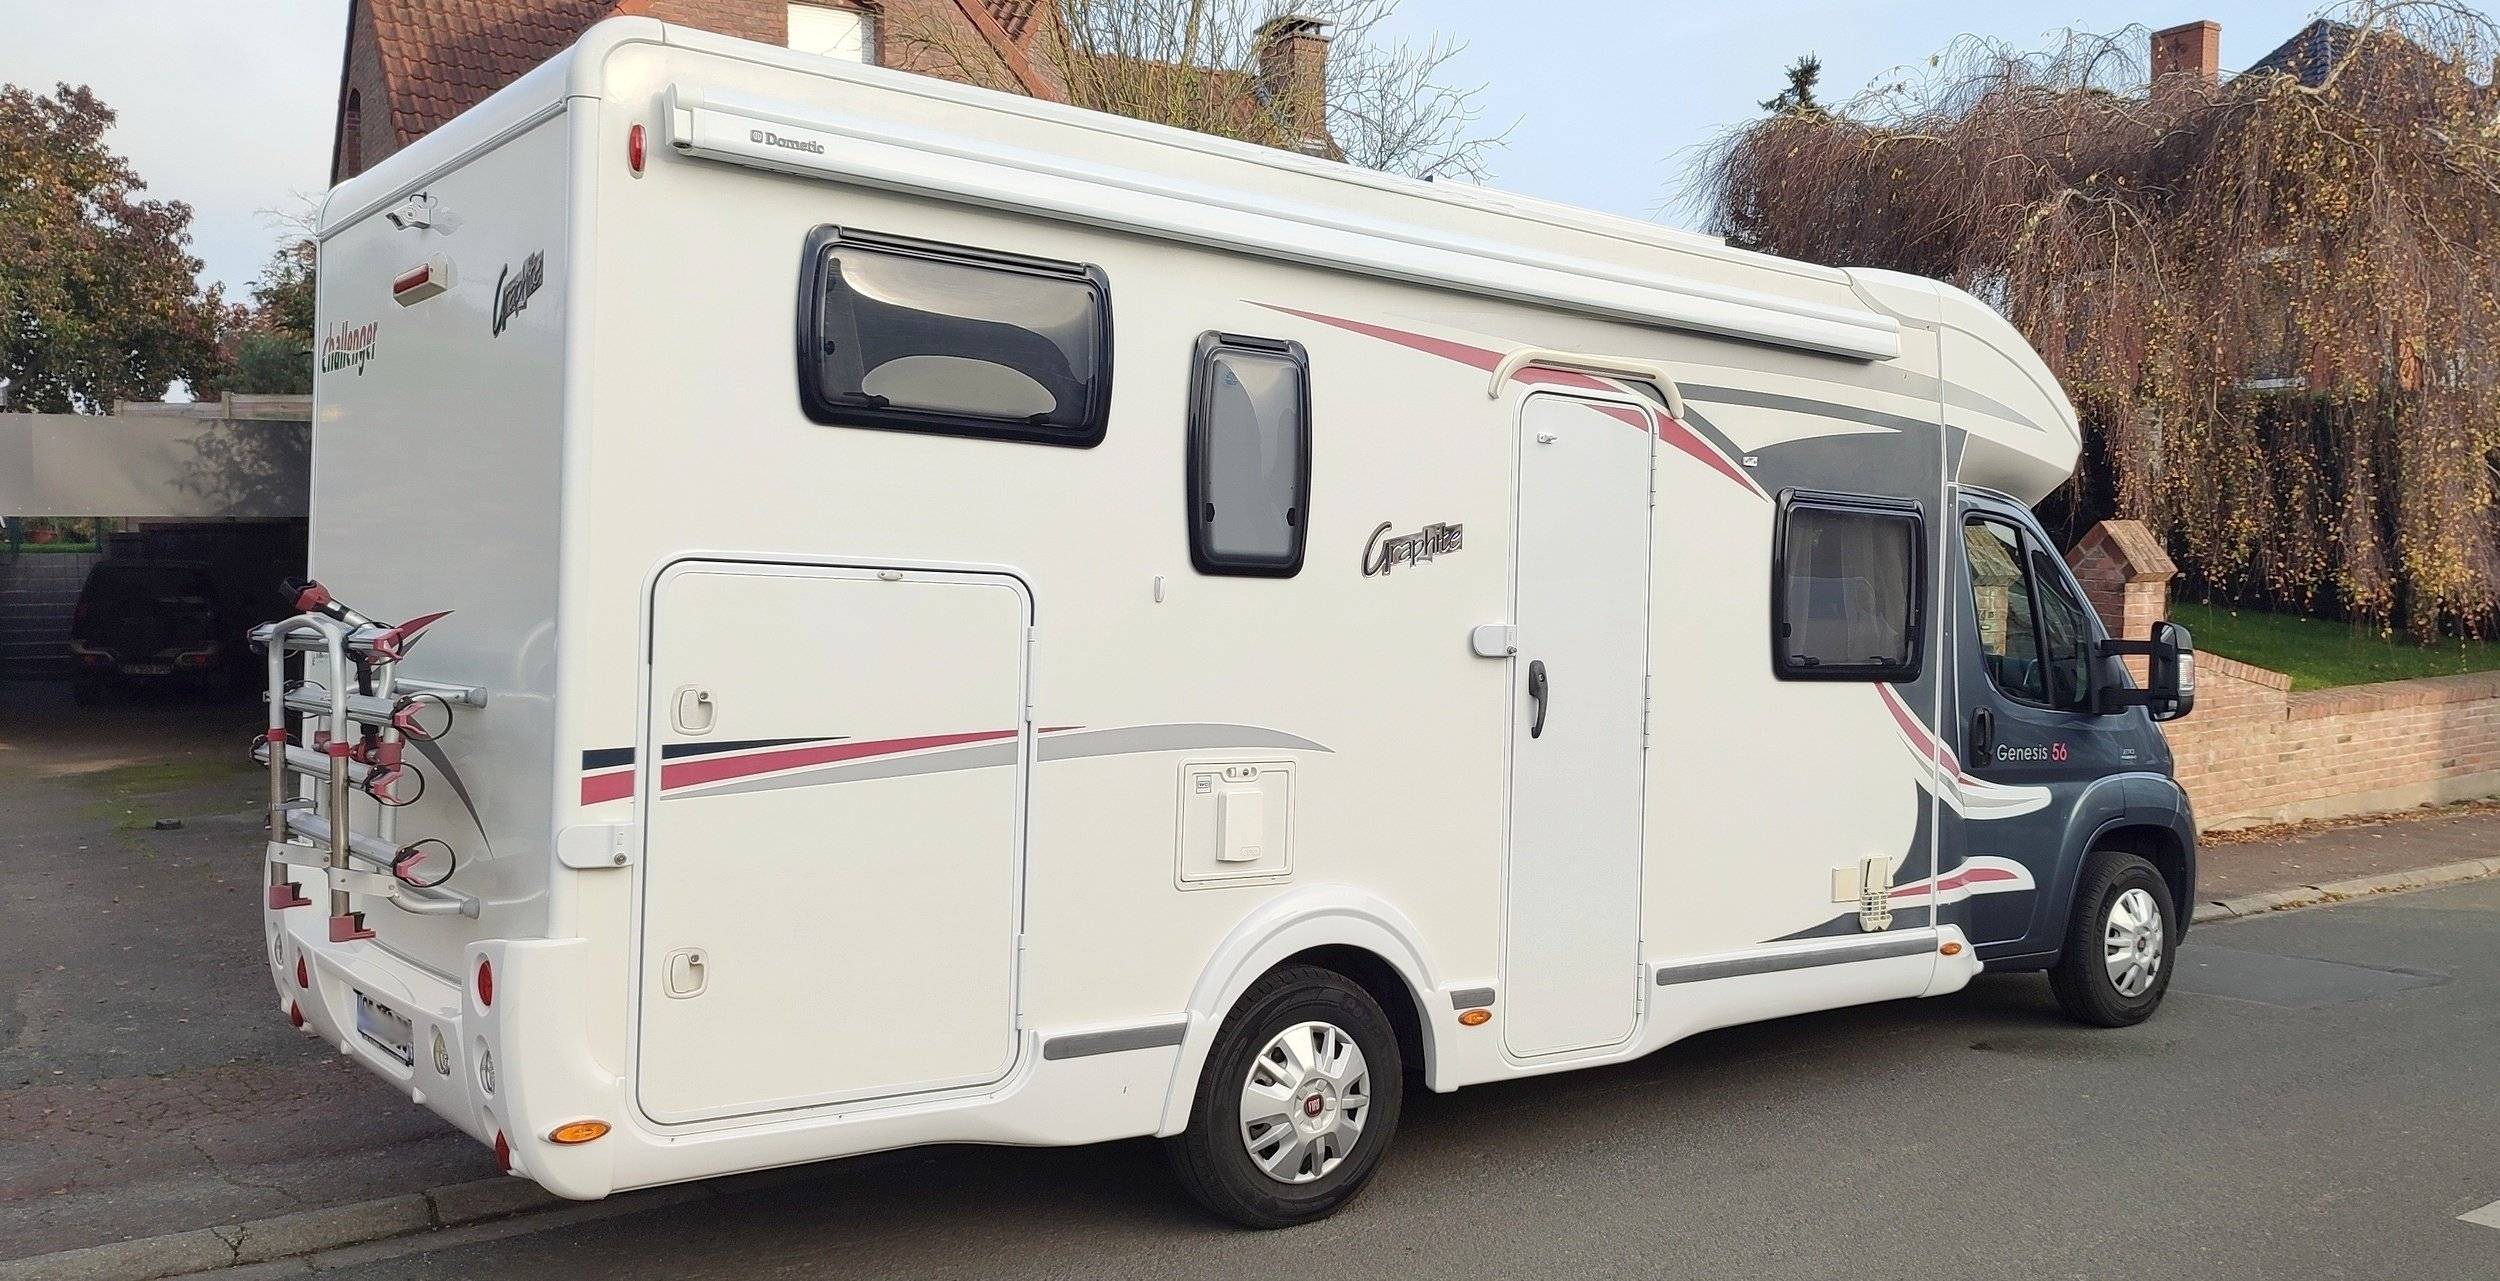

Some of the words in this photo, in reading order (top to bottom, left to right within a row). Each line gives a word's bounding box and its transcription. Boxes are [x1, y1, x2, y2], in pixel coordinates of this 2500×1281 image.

[765, 132, 825, 154] Dometic
[321, 320, 378, 377] challenger
[1361, 521, 1463, 577] Graphite
[1996, 743, 2048, 762] Genesis
[2051, 742, 2068, 762] 56
